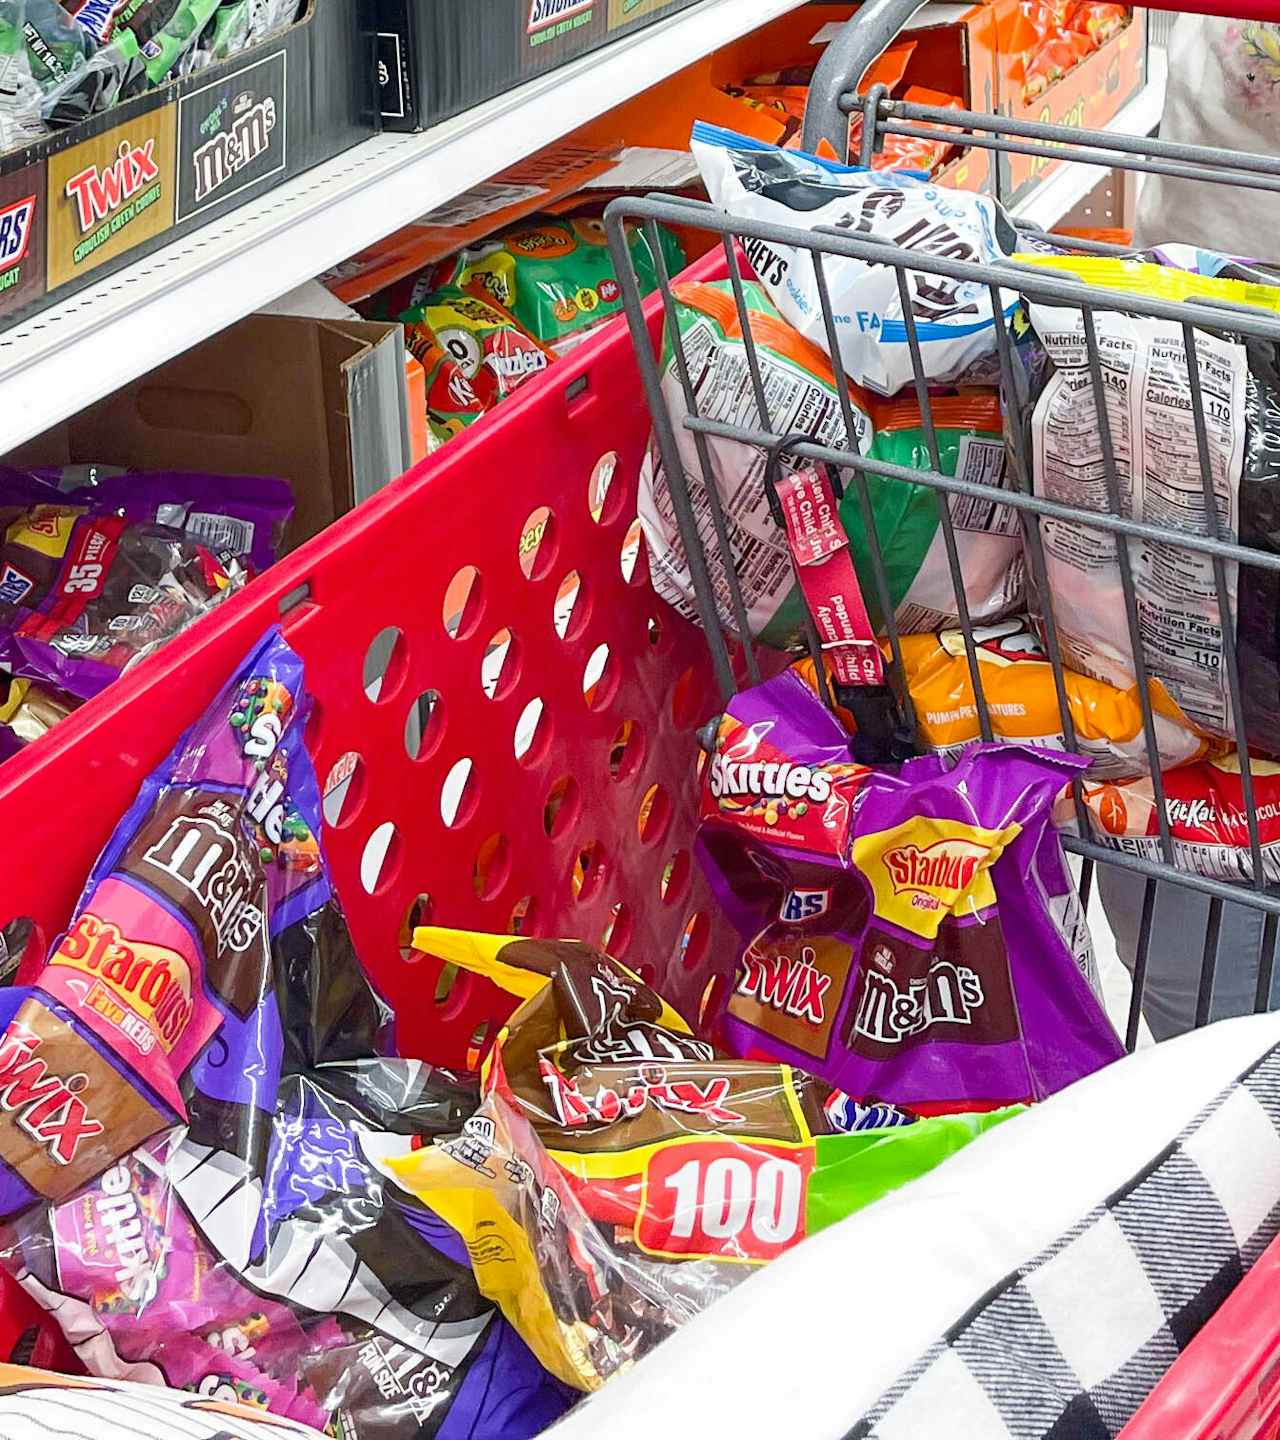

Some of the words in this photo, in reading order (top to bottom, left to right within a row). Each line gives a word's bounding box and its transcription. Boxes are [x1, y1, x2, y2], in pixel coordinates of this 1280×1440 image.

[64, 138, 160, 232] Twix
[73, 225, 111, 264] GHOULISH
[112, 208, 135, 236] GREEN
[1098, 336, 1134, 351] Facts
[1104, 371, 1128, 392] 140
[1205, 358, 1232, 383] Facts
[1145, 388, 1192, 409] Calories
[1209, 400, 1232, 421] 170
[64, 562, 104, 594] 35
[1188, 621, 1221, 638] Facts
[1193, 650, 1220, 667] 110
[710, 758, 832, 802] Skittles
[739, 947, 832, 1024] Twix
[666, 1159, 802, 1244] 100
[357, 1342, 382, 1378] FUN
[373, 1369, 402, 1399] SIZE
